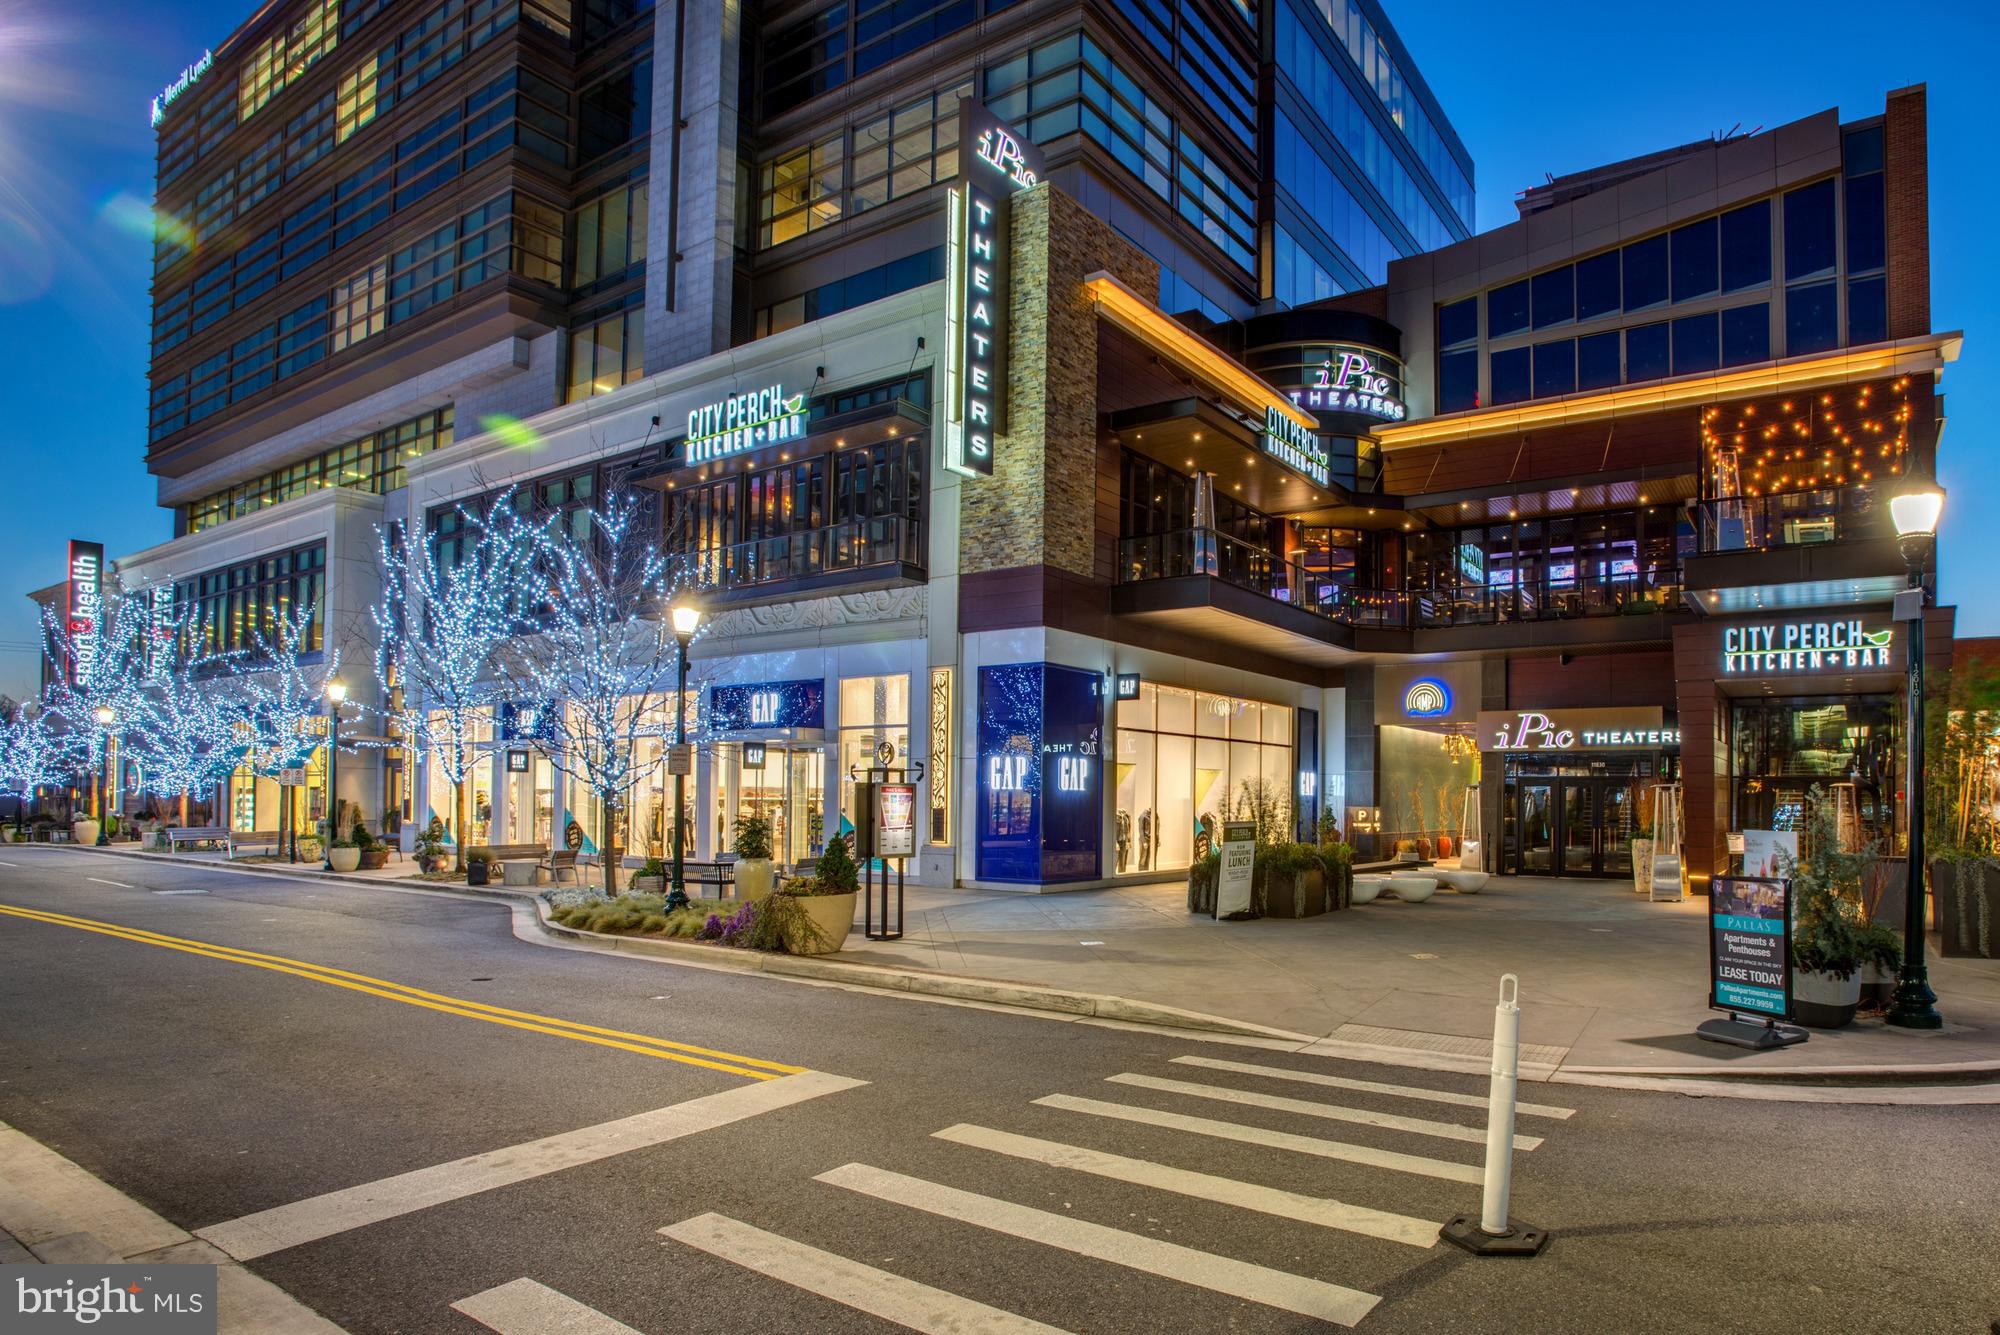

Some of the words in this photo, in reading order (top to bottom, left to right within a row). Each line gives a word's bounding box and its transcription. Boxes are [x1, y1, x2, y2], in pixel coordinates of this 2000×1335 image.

[164, 68, 188, 106] Merrill
[189, 48, 212, 83] Lynch
[977, 128, 1037, 190] iPic
[971, 200, 991, 457] THEATERS
[1314, 352, 1390, 396] iPic
[688, 401, 723, 441] CITY
[727, 384, 782, 430] PERCH
[1290, 392, 1403, 419] THEATERS
[687, 427, 753, 463] KITCHEN
[768, 415, 800, 442] BAR
[1268, 407, 1289, 438] CITY
[1290, 421, 1319, 460] PERCH
[1267, 434, 1306, 472] KITCHEN
[1312, 461, 1329, 486] BAR
[71, 554, 97, 618] health
[1725, 625, 1775, 652] CITY
[1785, 620, 1863, 650] PERCH
[1726, 651, 1821, 672] KITCHEN
[1847, 649, 1890, 667] BAR
[1120, 680, 1135, 694] GAP
[752, 692, 779, 723] GAP
[1493, 713, 1575, 749] iPic
[747, 750, 763, 764] GAP
[991, 757, 1027, 790] GAP
[1060, 757, 1088, 791] GAP
[1228, 856, 1251, 868] LUNCH
[1229, 849, 1251, 857] FEATURING
[1727, 917, 1771, 931] PALLAS
[1723, 933, 1767, 947] Apartments
[1768, 938, 1776, 948] &
[1728, 944, 1771, 957] Penthouses
[1719, 965, 1748, 981] LEASE
[1749, 970, 1783, 985] TODAY
[1720, 983, 1783, 1000] PallasApartments.com
